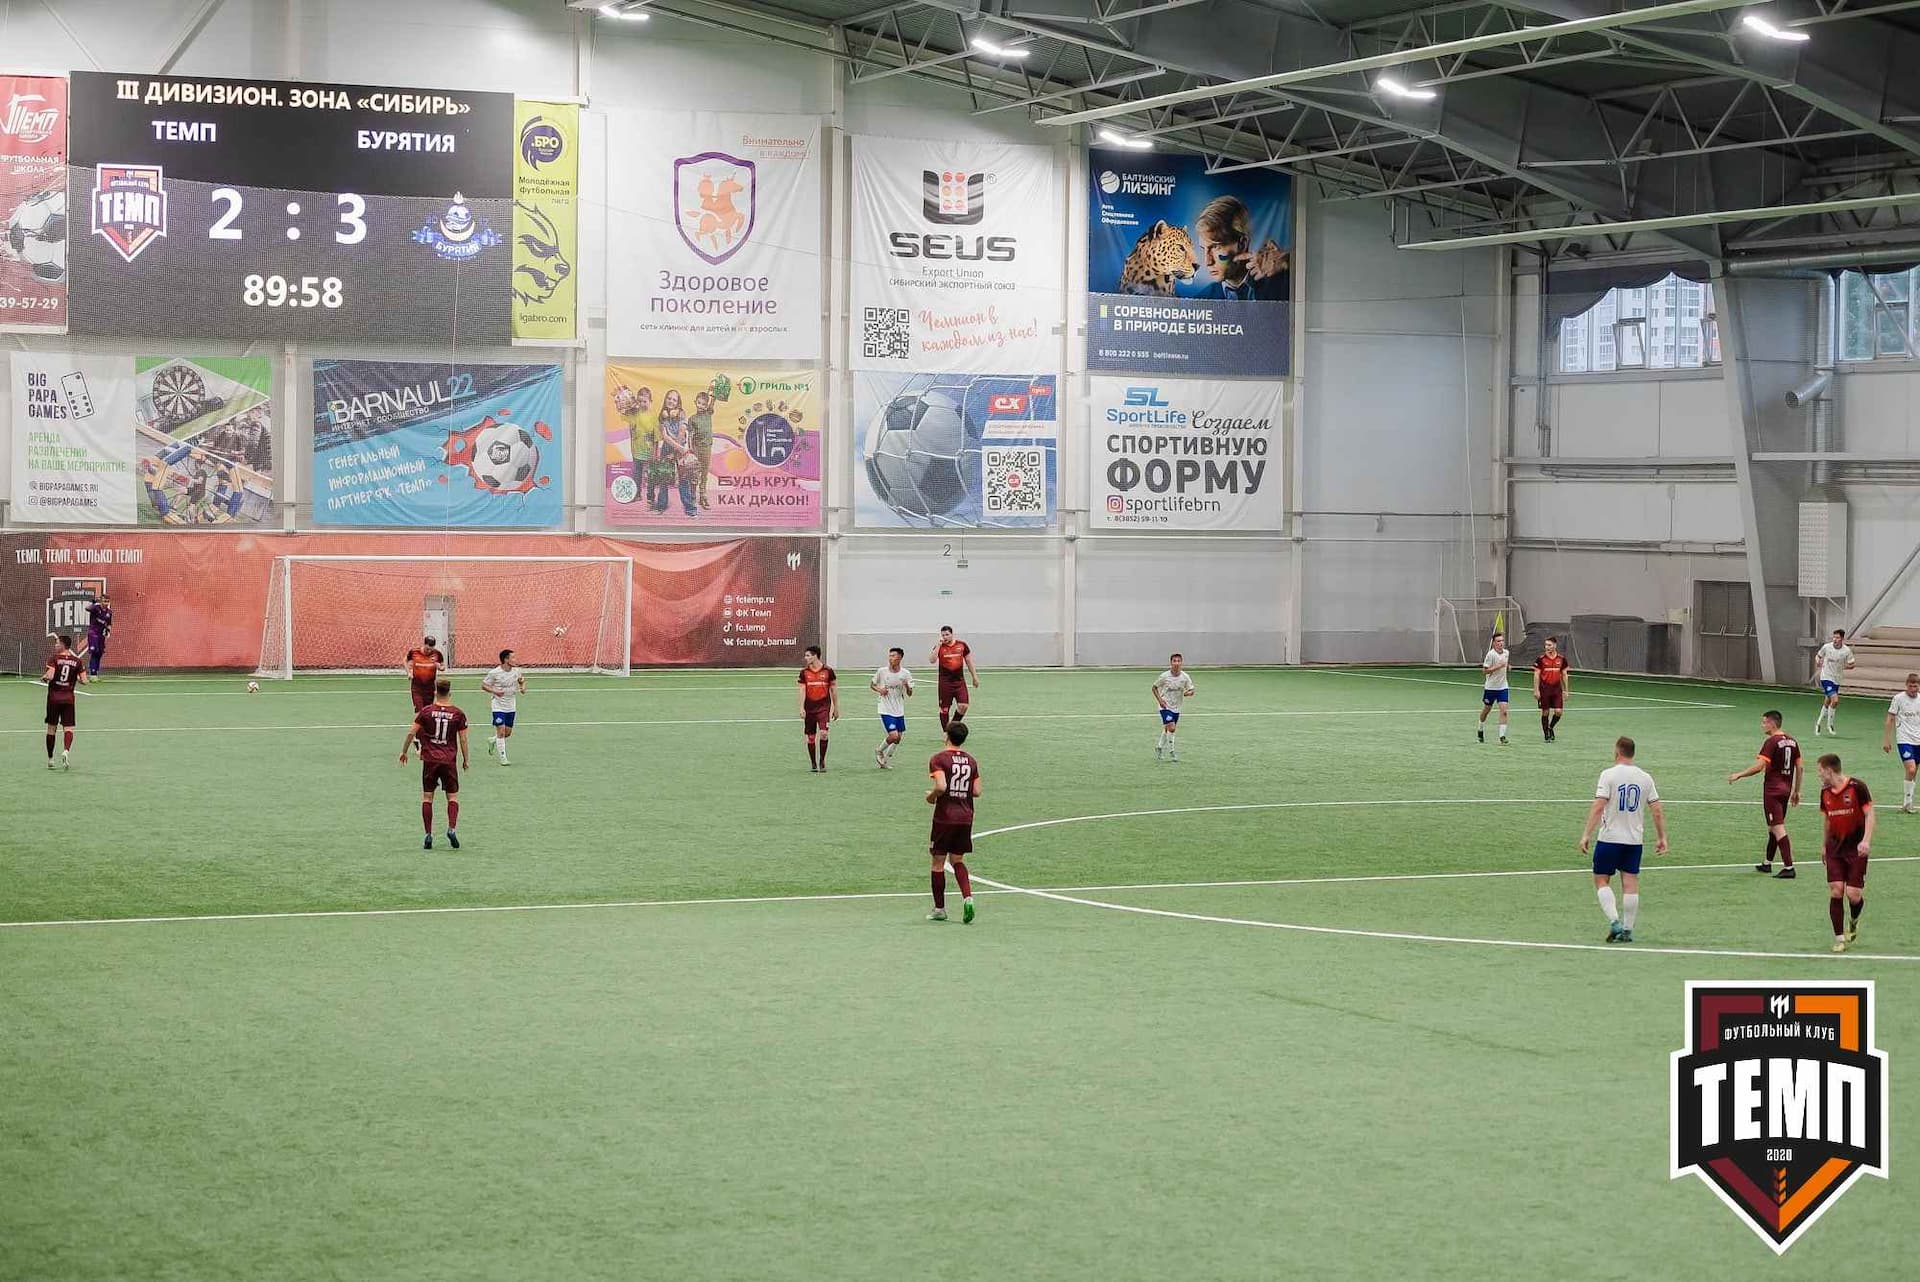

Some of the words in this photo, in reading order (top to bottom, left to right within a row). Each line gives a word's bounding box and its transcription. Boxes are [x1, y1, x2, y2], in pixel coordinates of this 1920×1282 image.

[117, 80, 139, 100] III
[144, 82, 283, 106] ДИВИЗИОН.
[289, 88, 351, 111] ЗОНА
[357, 93, 471, 115] «СИБИРЬ»
[152, 120, 216, 142] ТЕМП
[357, 130, 455, 152] БУРЯТИЯ
[1122, 173, 1176, 184] БАЛТИЙСКИЙ
[1121, 181, 1176, 195] ЛИЗИНГ
[100, 191, 160, 226] ТЕМП
[208, 188, 243, 240] 2
[287, 202, 300, 240] :
[335, 193, 367, 244] 3
[889, 232, 1017, 261] SEUS
[922, 266, 954, 279] Export
[956, 269, 984, 279] Union
[659, 270, 769, 293] Здоровое
[889, 277, 936, 289] СИБИРСКИЙ
[939, 280, 992, 290] ЭКСПОРТНЫЙ
[243, 275, 343, 308] 89:58
[650, 297, 777, 314] поколение
[1114, 305, 1213, 320] СОРЕВНОВАНИЕ
[918, 306, 985, 331] Чемпион
[1114, 320, 1122, 331] В
[1126, 320, 1186, 335] ПРИРОДЕ
[1188, 323, 1243, 335] БИЗНЕСА
[922, 330, 984, 351] каждом
[27, 372, 47, 386] BIG
[760, 382, 792, 391] ГРИЛЬ
[28, 388, 57, 403] PAPA
[28, 404, 67, 420] GAMES
[1106, 408, 1187, 425] SportLife
[1191, 410, 1272, 436] Создаем
[1107, 435, 1267, 455] СПОРТИВНУЮ
[328, 445, 400, 470] ГЕНЕРАЛЬНЫЙ
[1107, 458, 1266, 494] ФОРМУ
[374, 487, 392, 500] ФК
[717, 494, 745, 506] КАК
[749, 494, 809, 508] ДРАКОН!
[1126, 496, 1221, 514] sportlifebrn
[15, 549, 43, 565] ТЕМП,
[45, 549, 74, 565] ТЕМП,
[76, 548, 113, 564] ТОЛЬКО
[115, 548, 143, 564] ТЕМП!
[943, 544, 952, 556] 2
[735, 595, 775, 605] fctemp.ru
[53, 600, 92, 627] ТЕМ
[750, 609, 771, 617] Темп
[60, 665, 70, 681] 9
[435, 718, 448, 740] 11
[950, 763, 971, 791] 22
[1617, 783, 1641, 812] 10
